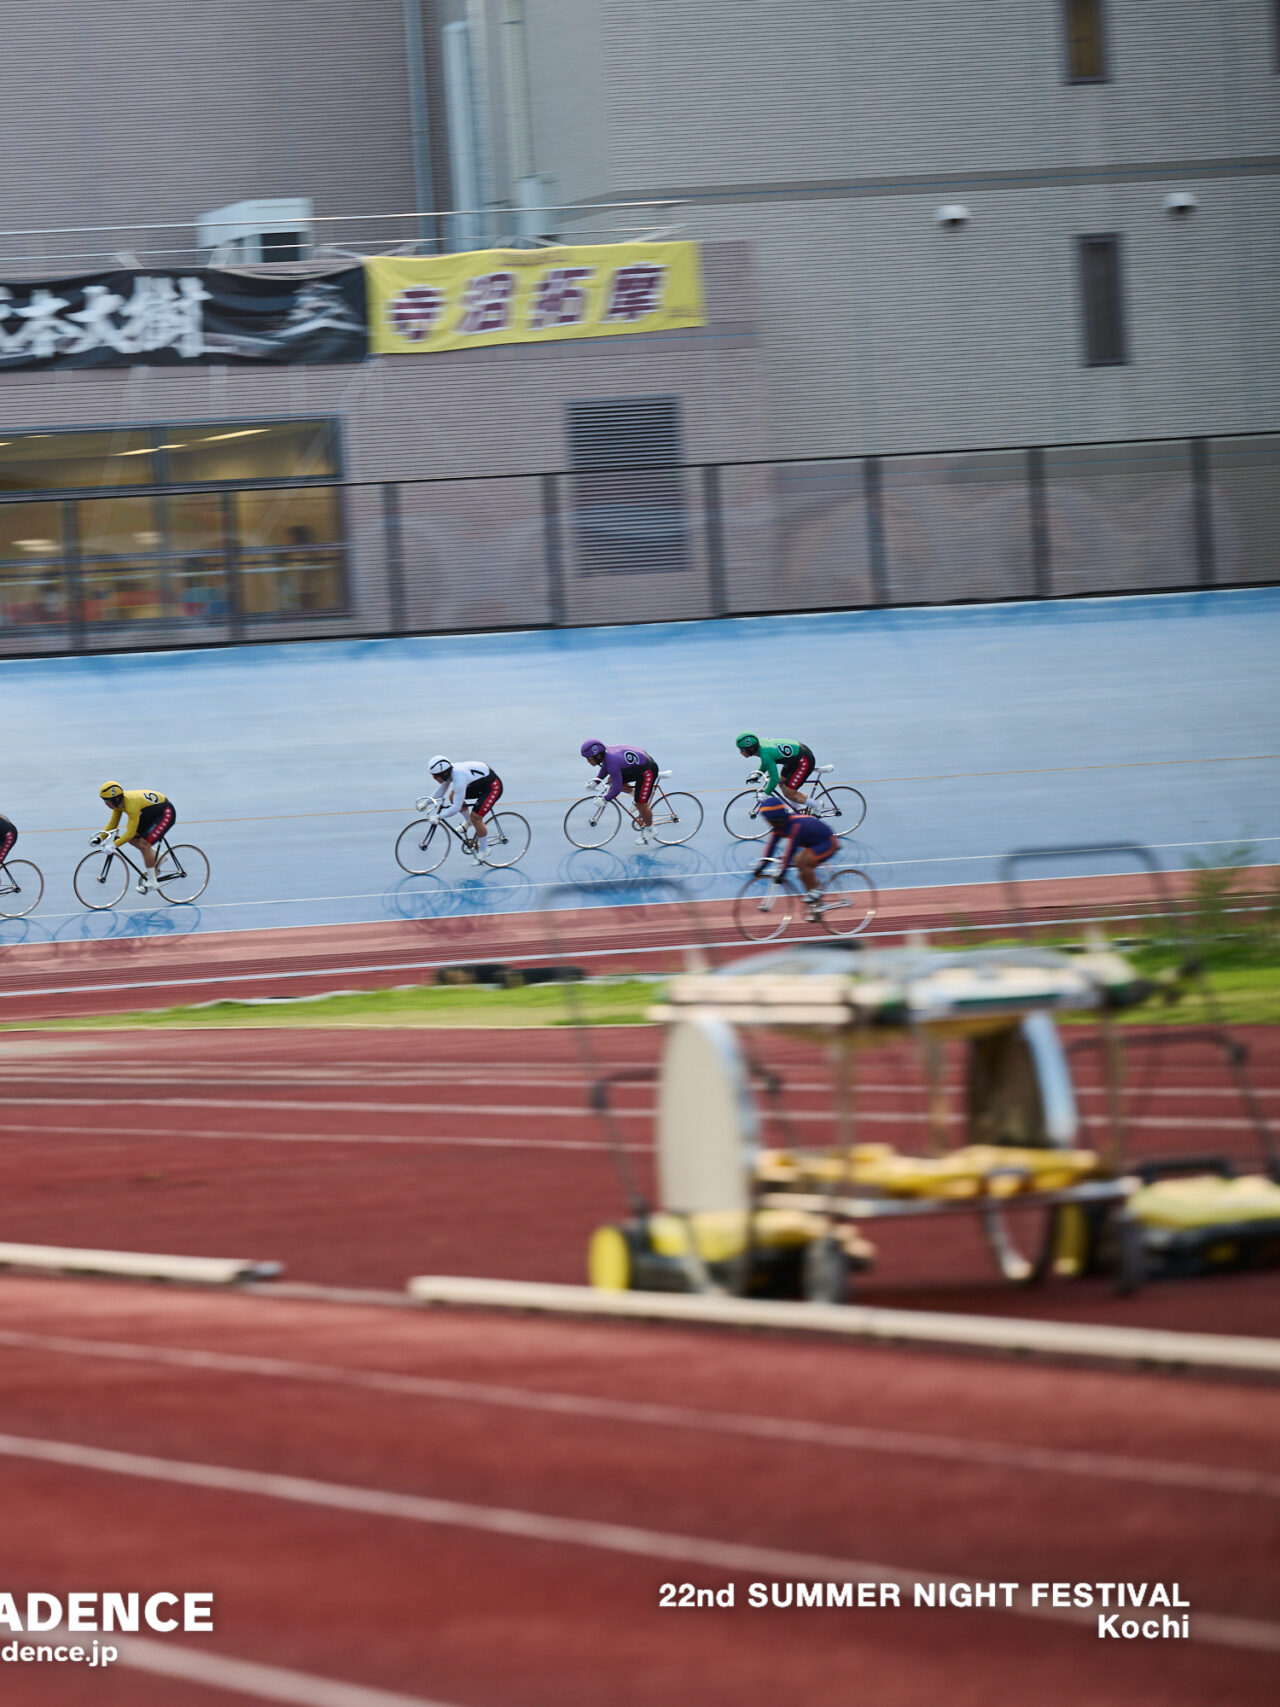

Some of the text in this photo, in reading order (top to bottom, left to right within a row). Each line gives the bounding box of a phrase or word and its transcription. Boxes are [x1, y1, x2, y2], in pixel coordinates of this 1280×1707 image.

[778, 744, 793, 757] 6
[624, 750, 640, 765] 9
[143, 792, 159, 804] 5
